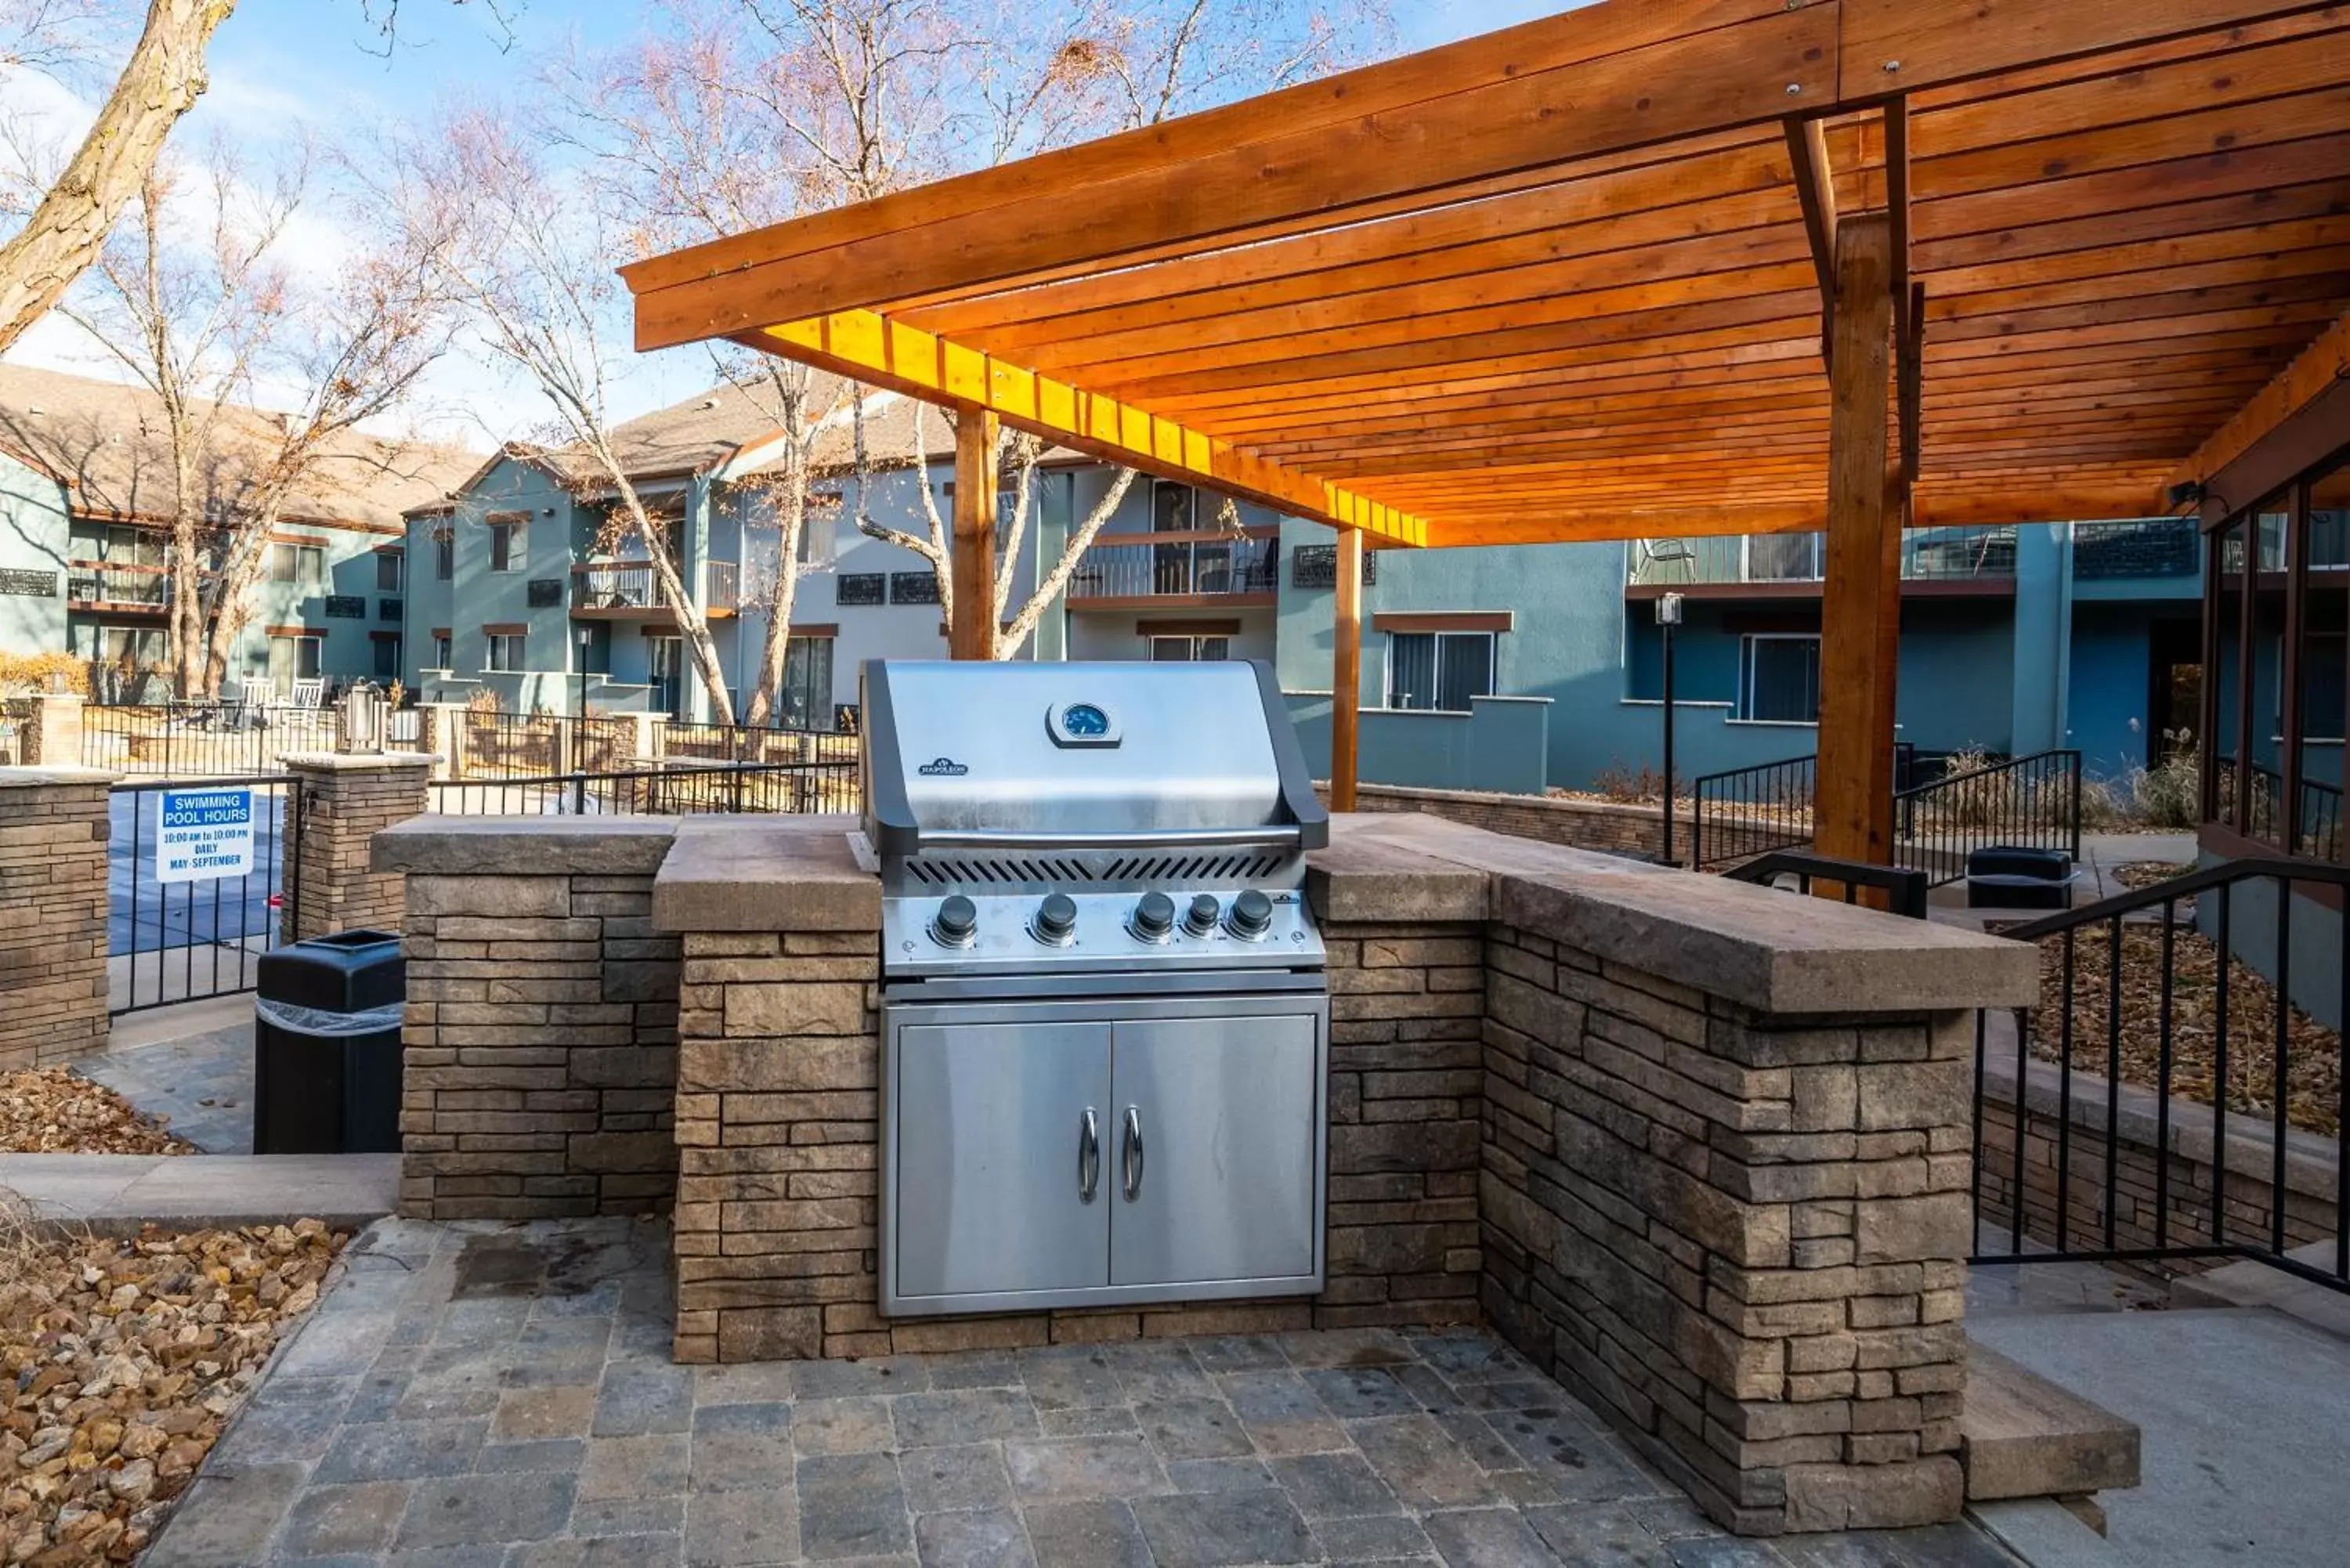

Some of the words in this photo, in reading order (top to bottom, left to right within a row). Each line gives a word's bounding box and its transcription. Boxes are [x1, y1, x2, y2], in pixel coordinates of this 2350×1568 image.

[175, 795, 240, 810] SWIMMING
[165, 812, 201, 825] POOL
[204, 808, 248, 822] HOURS
[164, 833, 187, 844] 10:00
[190, 833, 200, 842] AM
[203, 831, 212, 840] to
[238, 829, 248, 838] PM
[195, 843, 219, 854] DAILY
